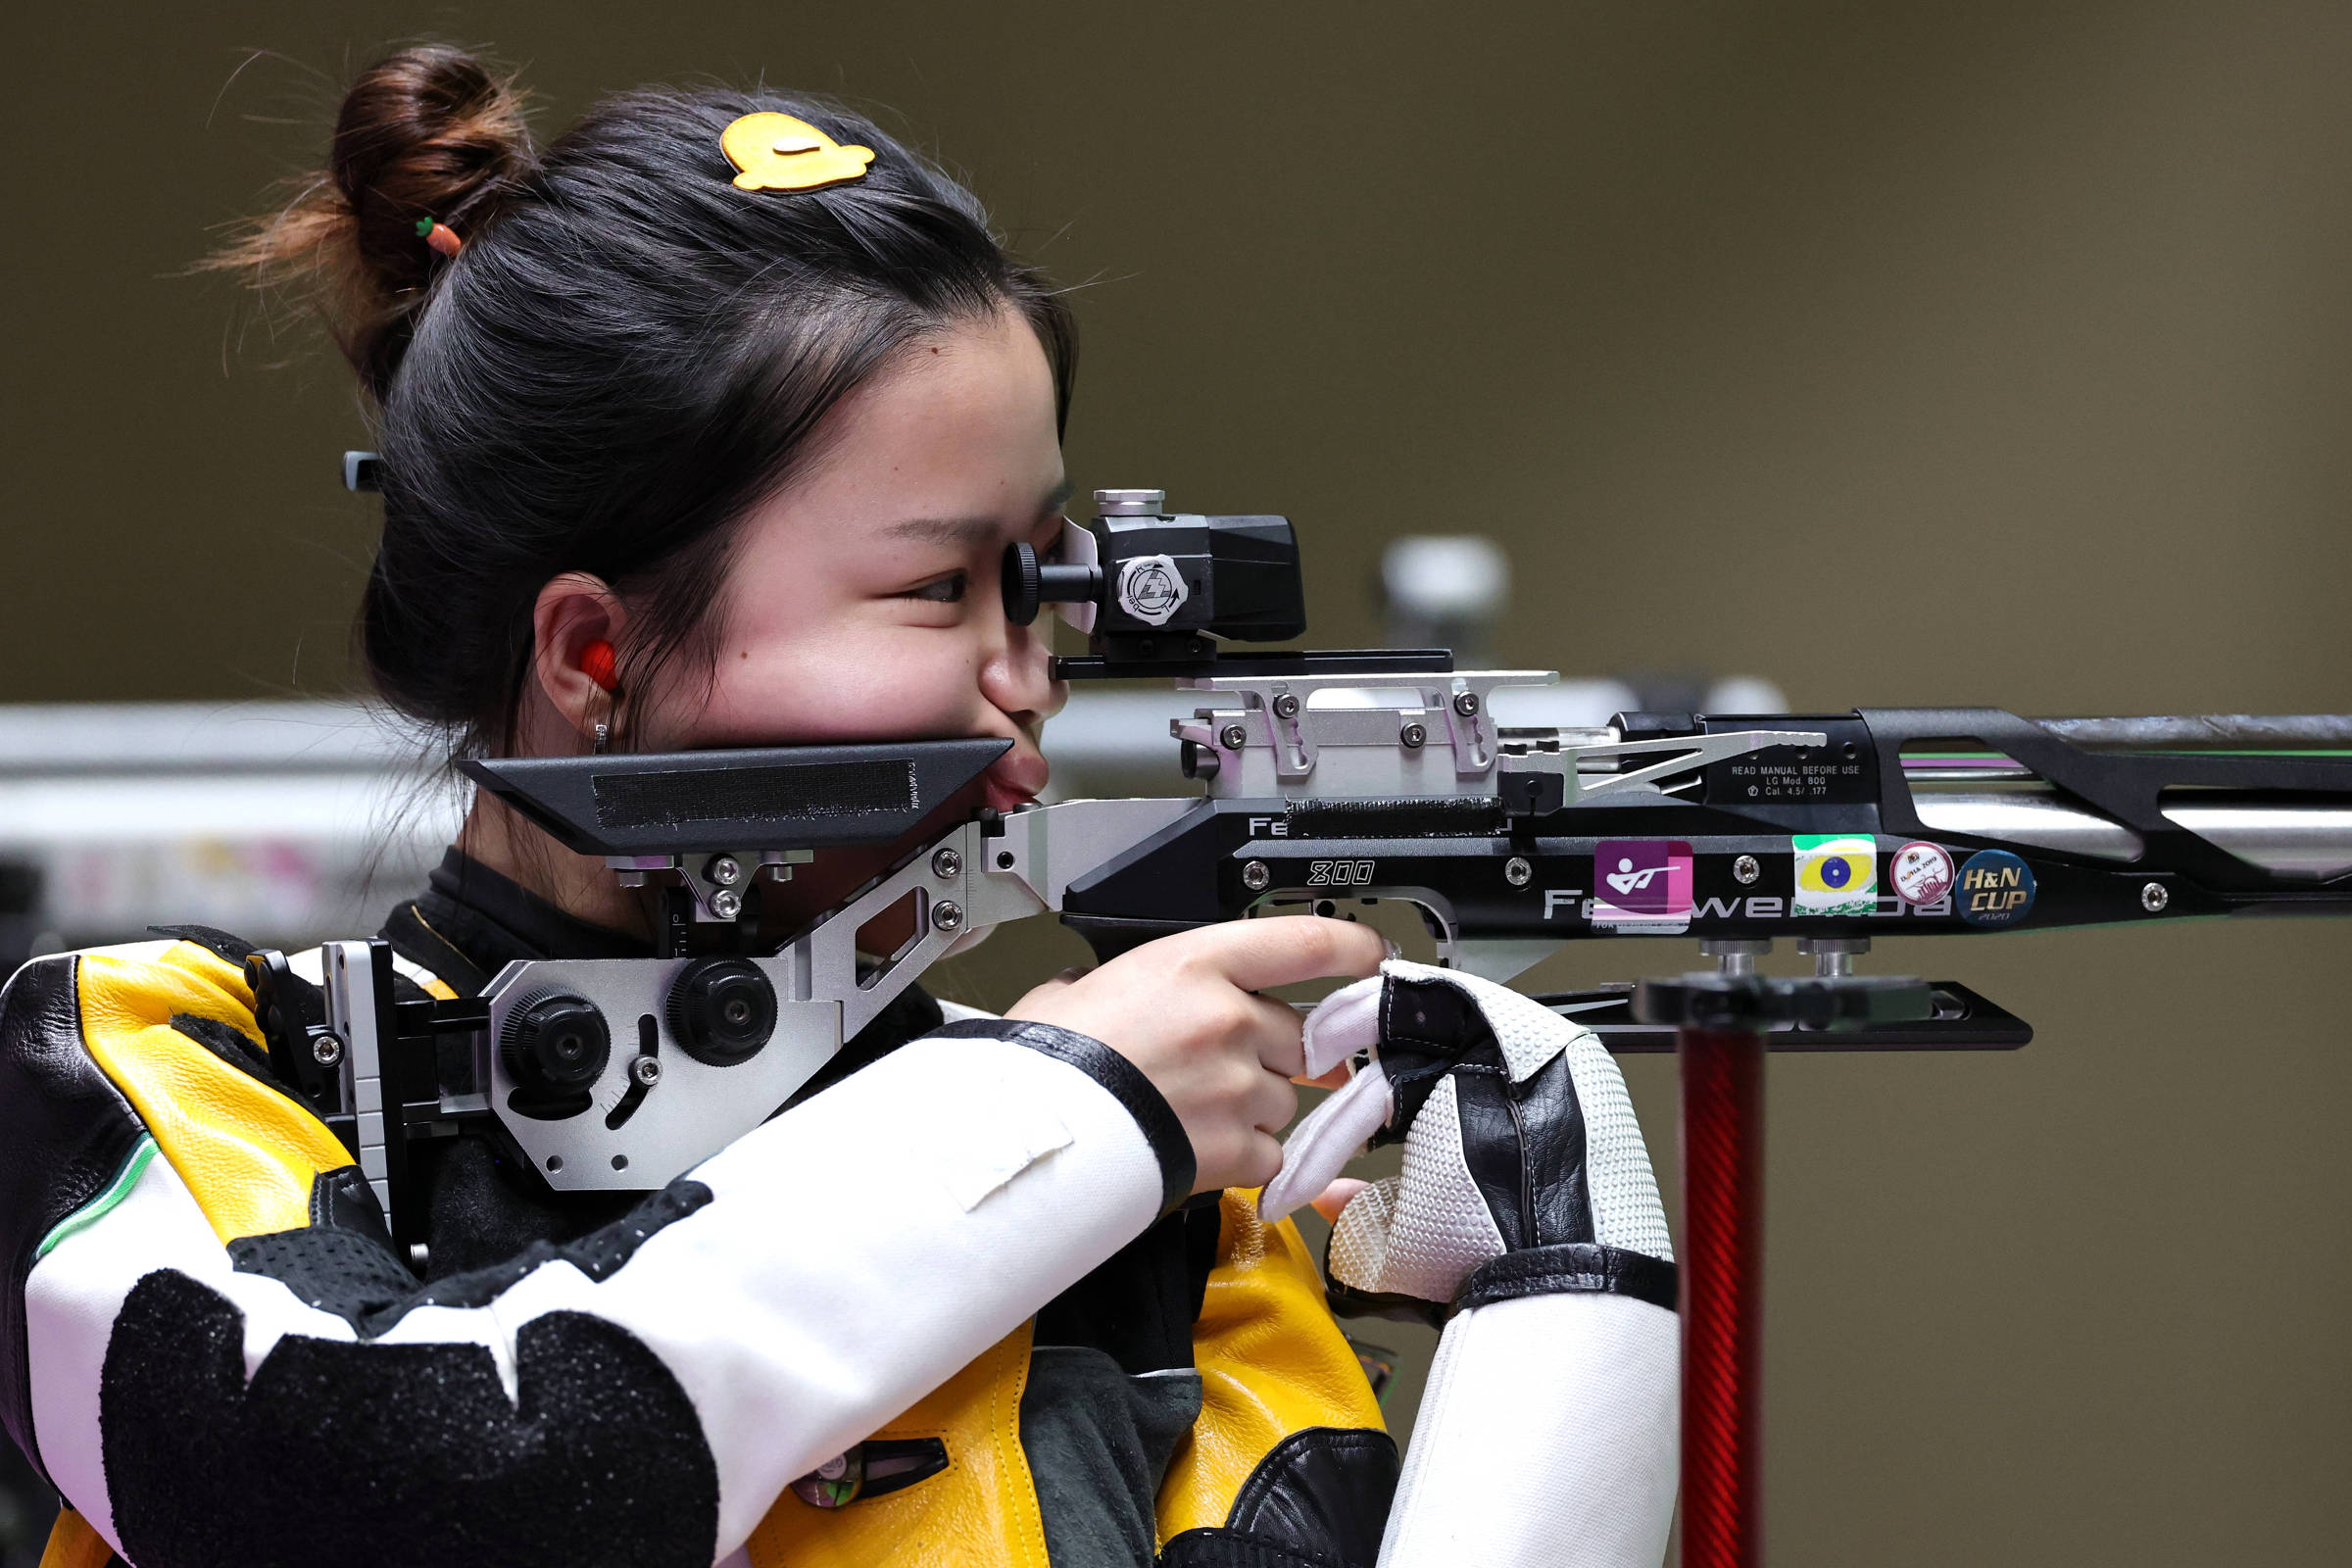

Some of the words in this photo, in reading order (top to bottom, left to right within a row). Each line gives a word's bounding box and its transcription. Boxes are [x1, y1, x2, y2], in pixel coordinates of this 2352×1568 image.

[1732, 766, 1756, 775] READ
[1760, 766, 1798, 775] MANUAL
[1802, 765, 1838, 775] BEFORE
[1841, 765, 1860, 774] USE
[1766, 776, 1779, 785] LG
[1807, 776, 1826, 785] 800
[1922, 856, 1937, 869] 2019
[1307, 860, 1375, 886] 800
[1963, 866, 2022, 891] H&N
[1970, 890, 2028, 912] CUP
[672, 913, 679, 923] 0
[1978, 911, 2011, 921] 2020
